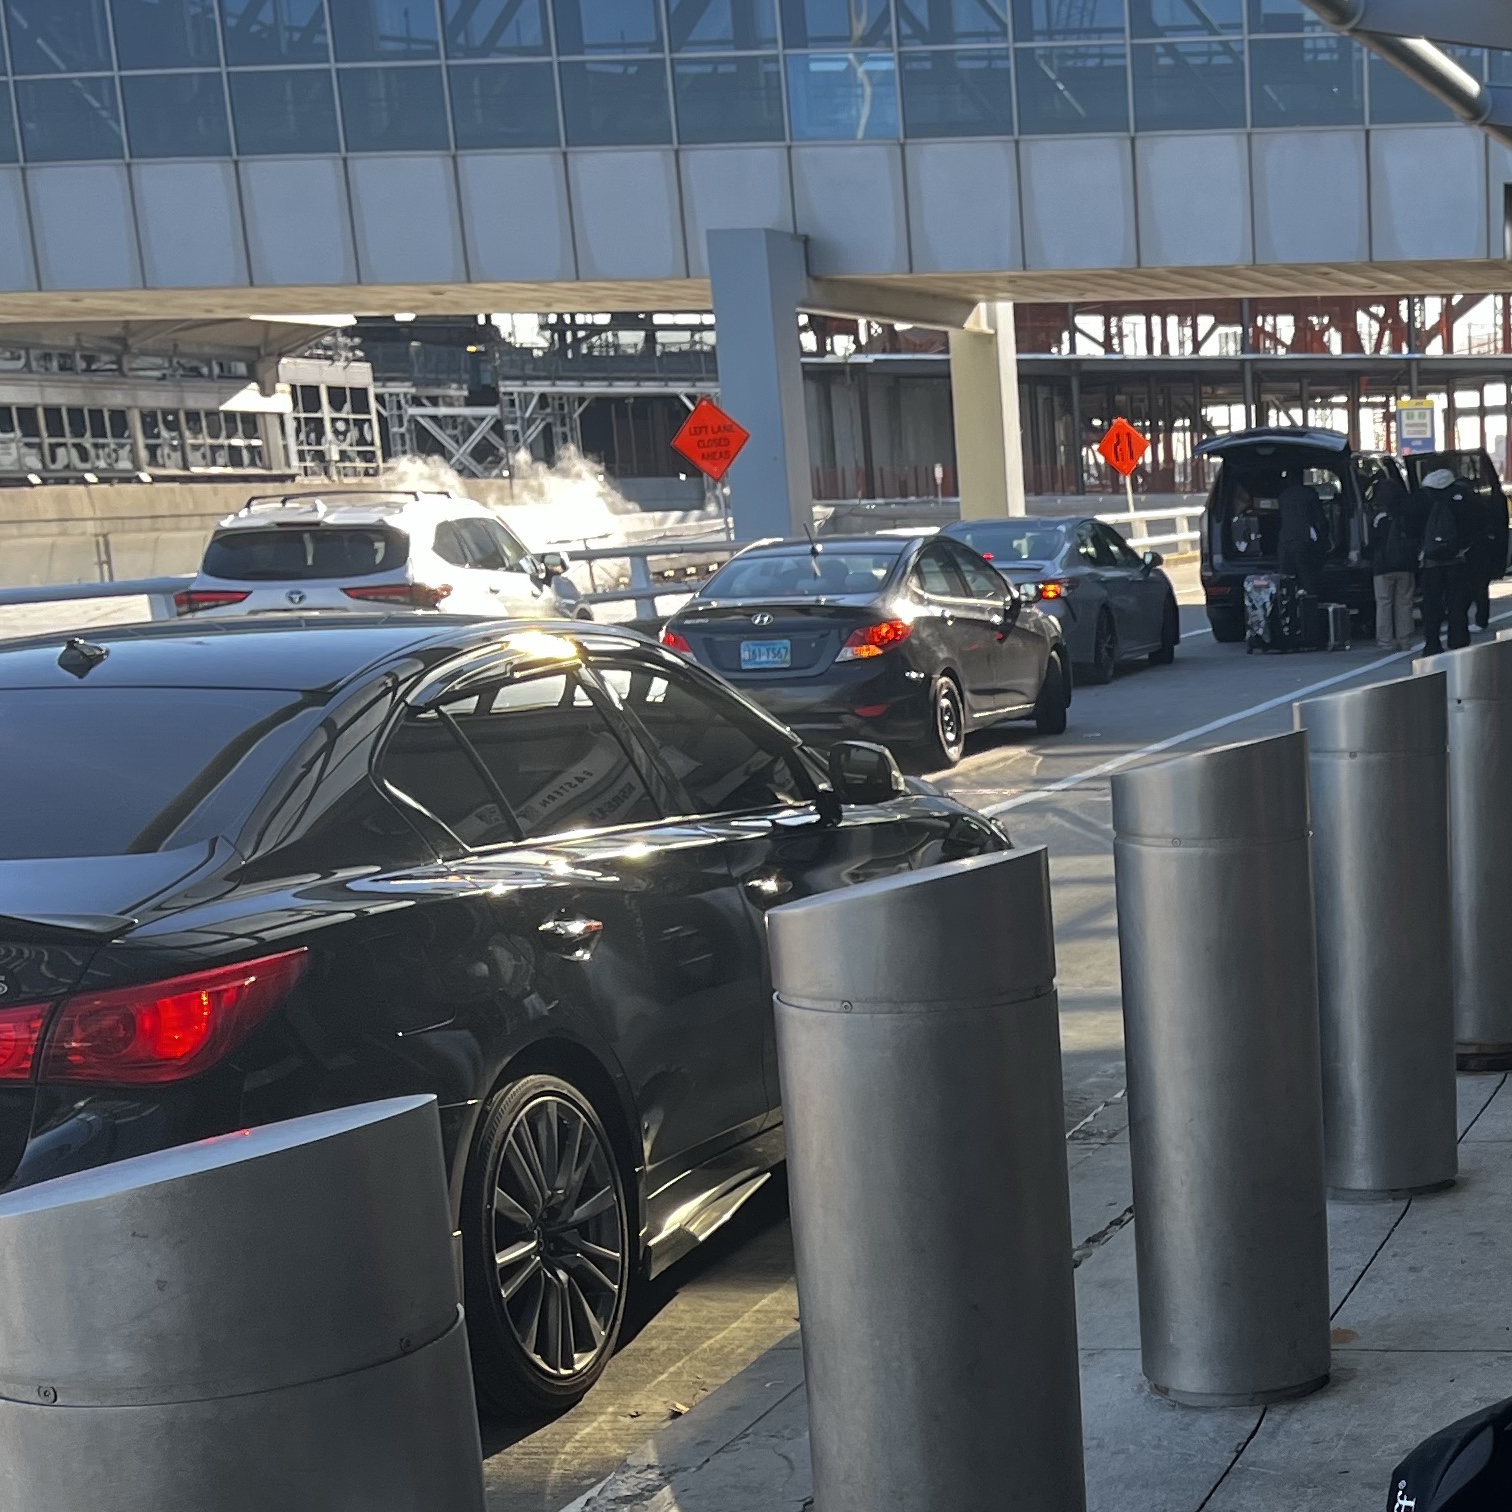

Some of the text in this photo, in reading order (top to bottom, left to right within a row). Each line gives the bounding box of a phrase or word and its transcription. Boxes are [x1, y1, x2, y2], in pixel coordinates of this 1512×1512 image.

[688, 424, 735, 436] LEFT LANE
[696, 437, 730, 449] CLOSED
